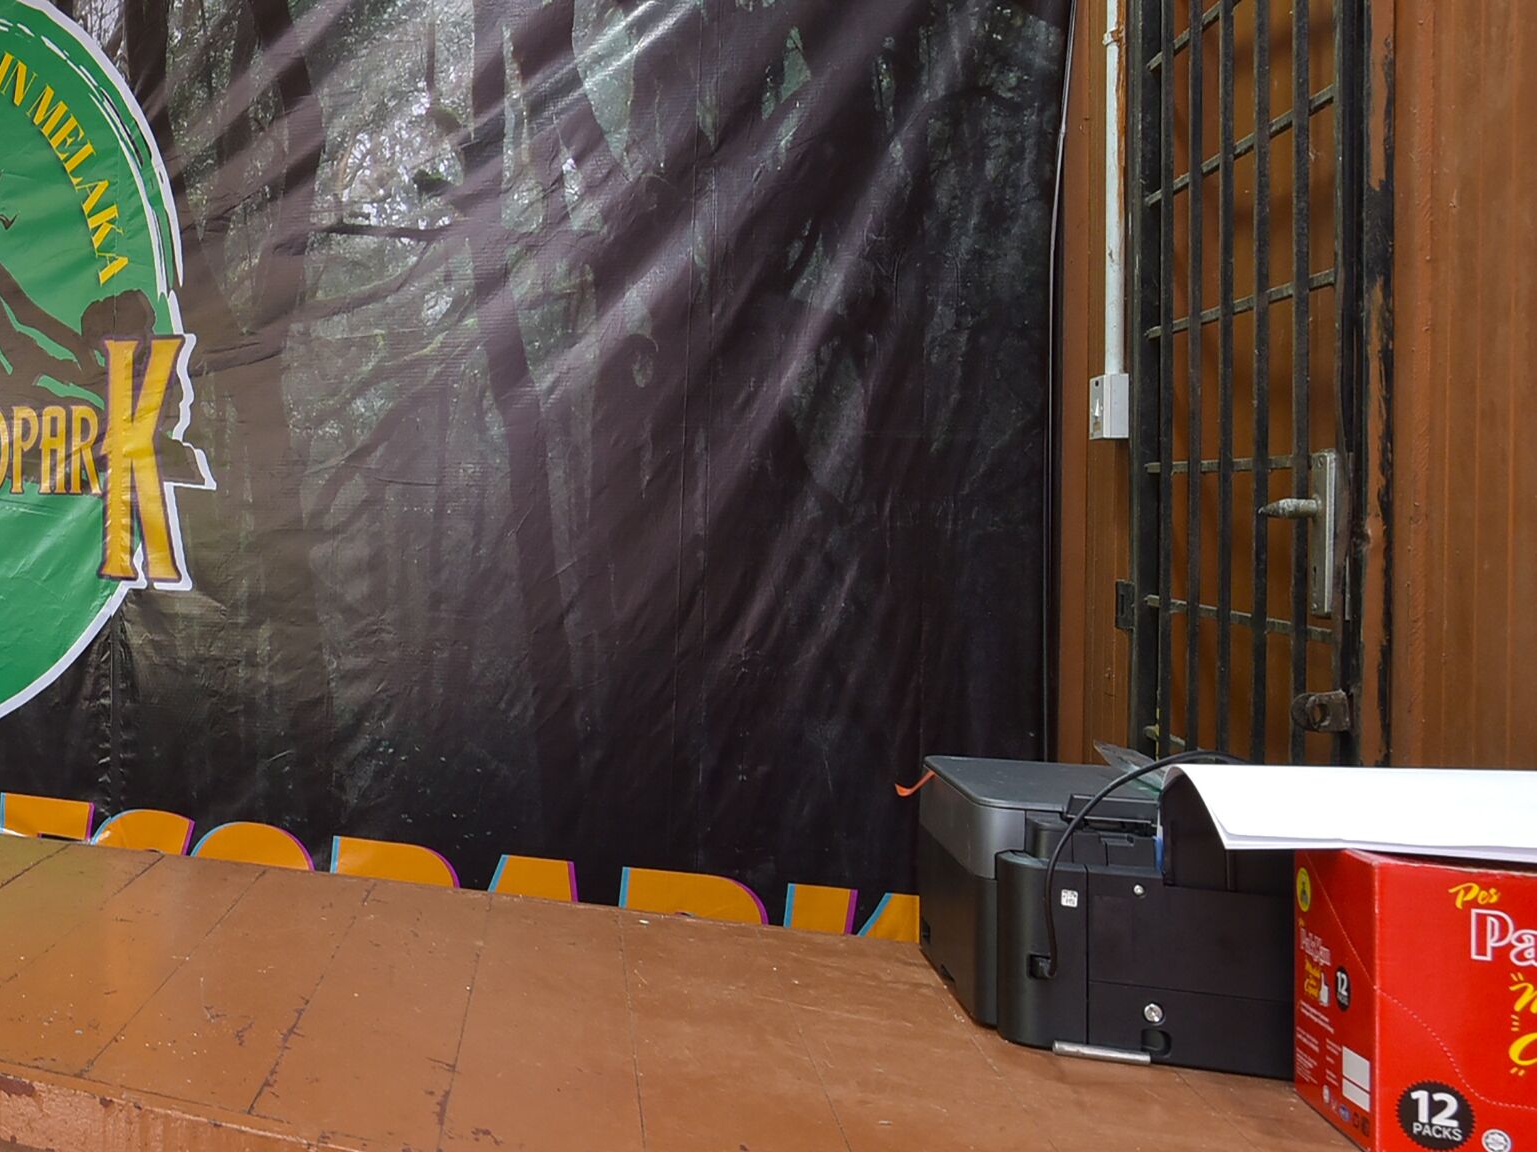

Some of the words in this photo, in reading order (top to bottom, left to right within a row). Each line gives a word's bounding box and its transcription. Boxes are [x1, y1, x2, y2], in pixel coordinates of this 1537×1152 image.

[25, 85, 130, 286] MELAKA
[1448, 882, 1501, 910] Pes
[1410, 1089, 1460, 1128] 12
[1412, 1122, 1463, 1142] PACKS
